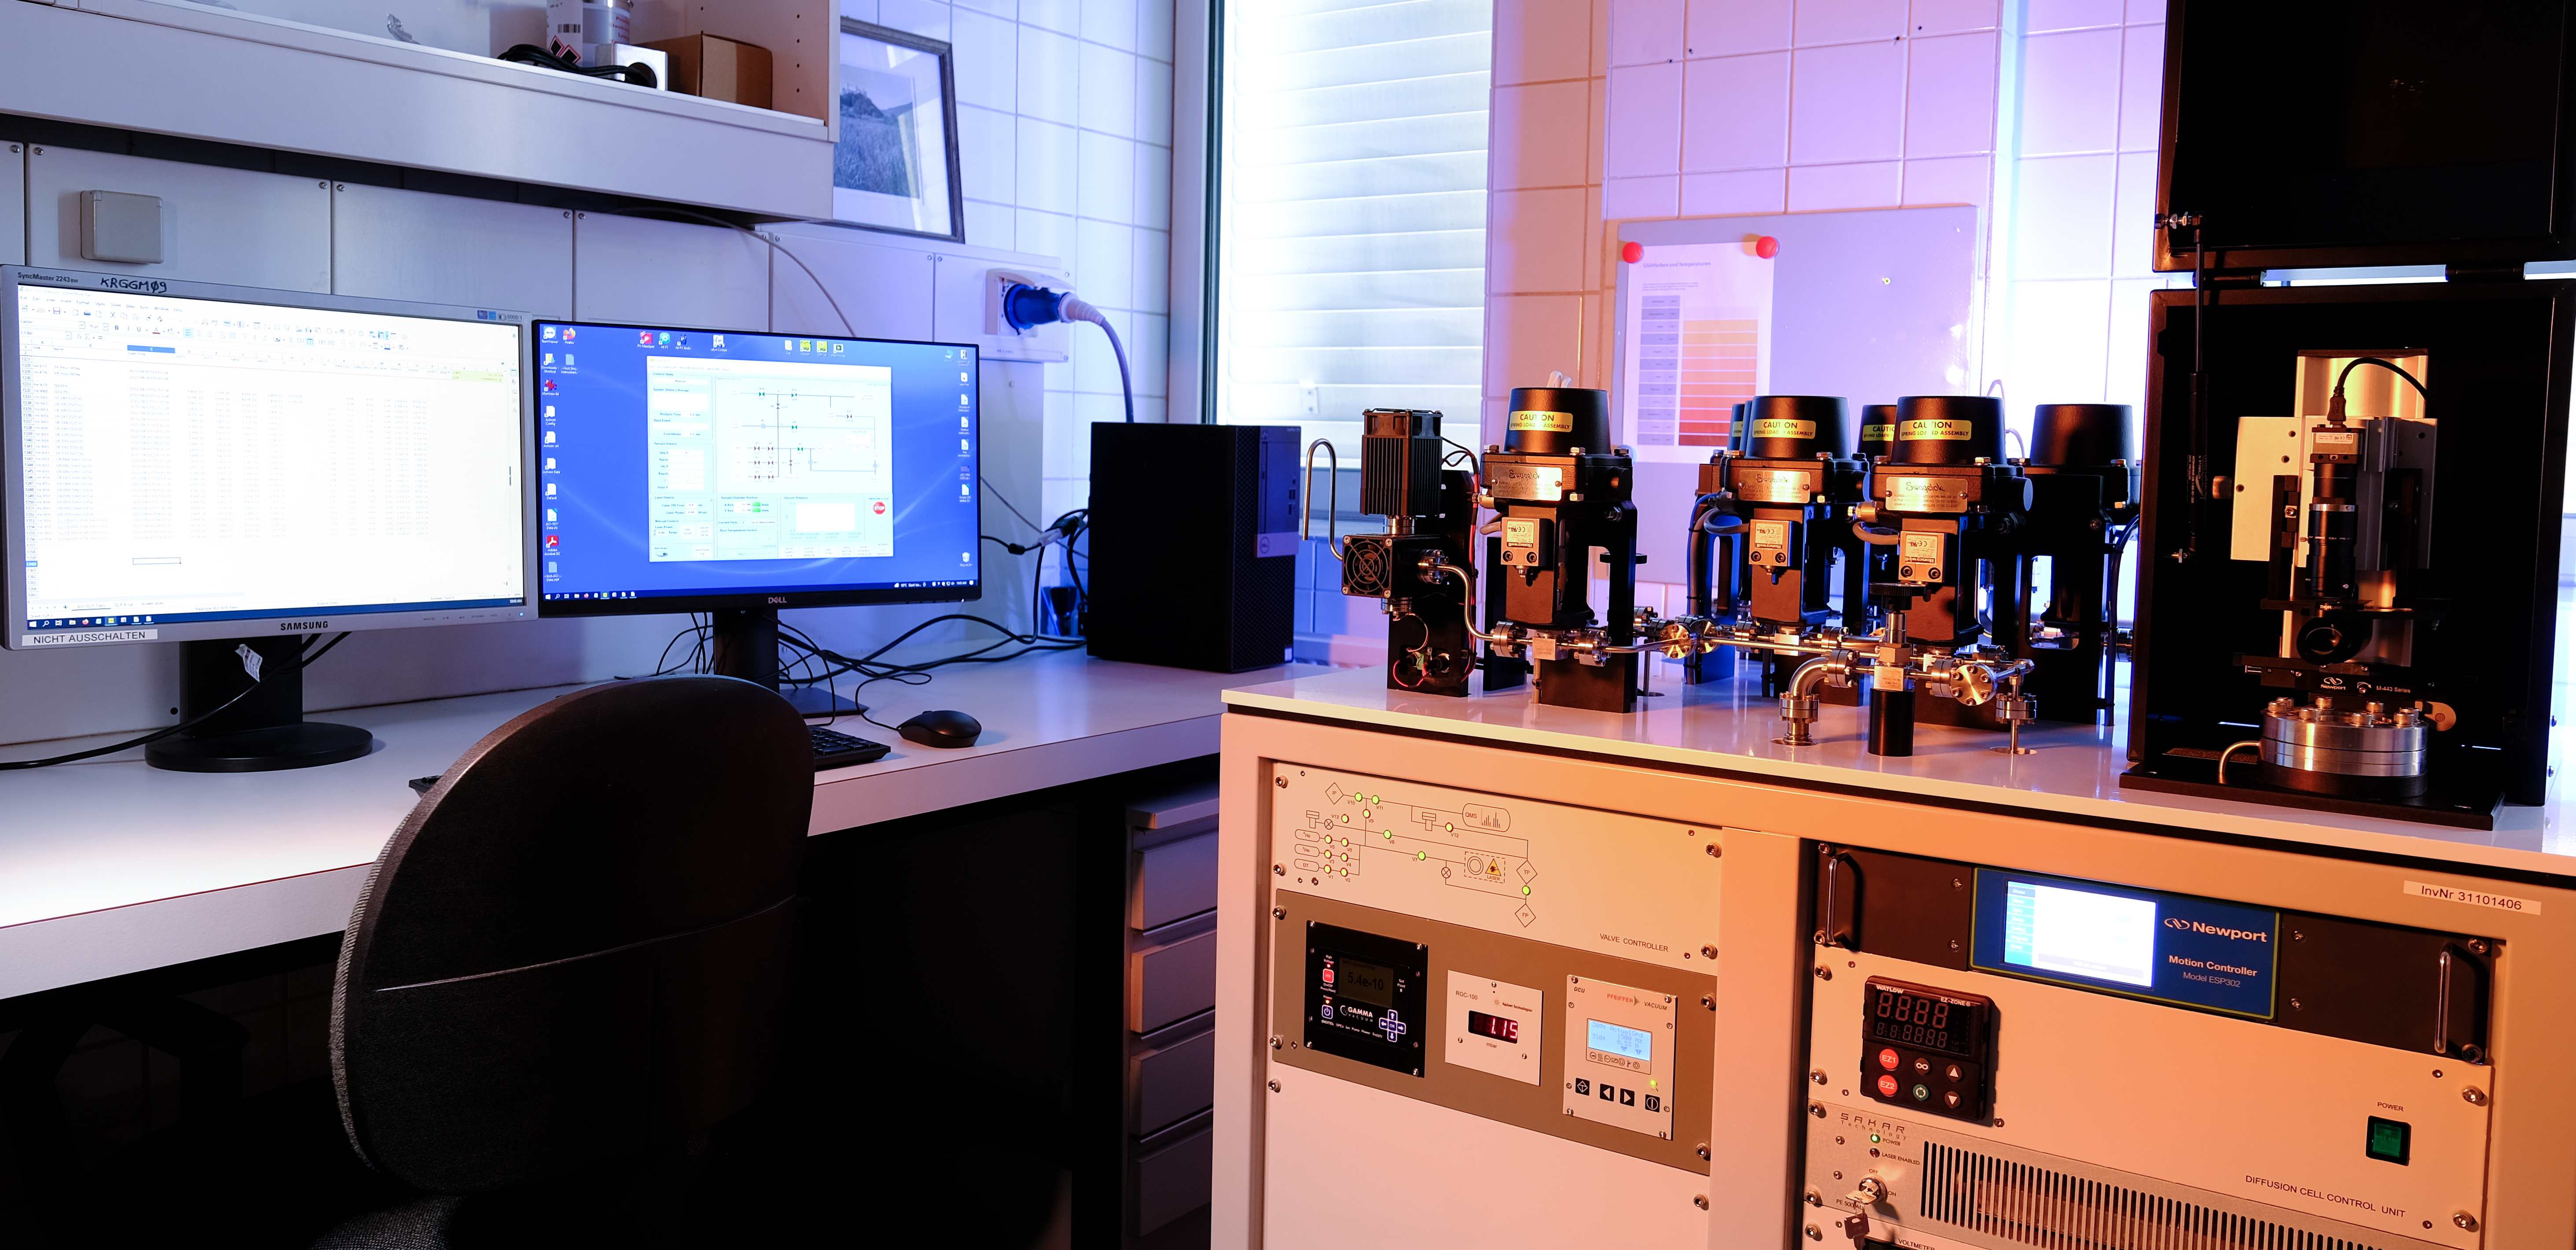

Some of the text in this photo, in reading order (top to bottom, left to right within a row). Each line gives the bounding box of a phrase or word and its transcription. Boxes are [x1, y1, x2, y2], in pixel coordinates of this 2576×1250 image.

[18, 272, 54, 282] SyncMaster
[1906, 481, 1945, 493] Swagelok
[768, 596, 787, 605] DELL
[280, 620, 329, 631] SAMSUNG
[33, 631, 146, 644] NICHT AUSSCHALTEN
[2422, 885, 2522, 910] InvNr 31101406
[2192, 920, 2267, 943] Newport
[1600, 933, 1669, 952] VALVE CONTROLLER
[2168, 955, 2258, 977] Motion Controller
[1348, 971, 1384, 991] 5.4e-10
[2183, 971, 2241, 988] Model ESP302
[1455, 990, 1478, 1000] RGC-100
[1876, 984, 1904, 994] WATLOW
[1607, 993, 1668, 1011] PFEIFFER VACUUM
[1348, 1007, 1373, 1018] GAMMA
[1349, 1014, 1373, 1023] VACUUM
[1491, 1017, 1518, 1039] 1.15
[1881, 1054, 1896, 1063] EZ1
[1880, 1080, 1895, 1090] EZ2
[2377, 1101, 2404, 1112] POWER
[1840, 1112, 1905, 1133] SAKAR
[1841, 1120, 1907, 1140] Technology
[1882, 1138, 1901, 1147] POWER
[1898, 1156, 1920, 1166] ENABLED
[2245, 1175, 2406, 1218] DIFFUSION CELL CONTROL UNIT
[1898, 1238, 1935, 1250] VOLTMETER
